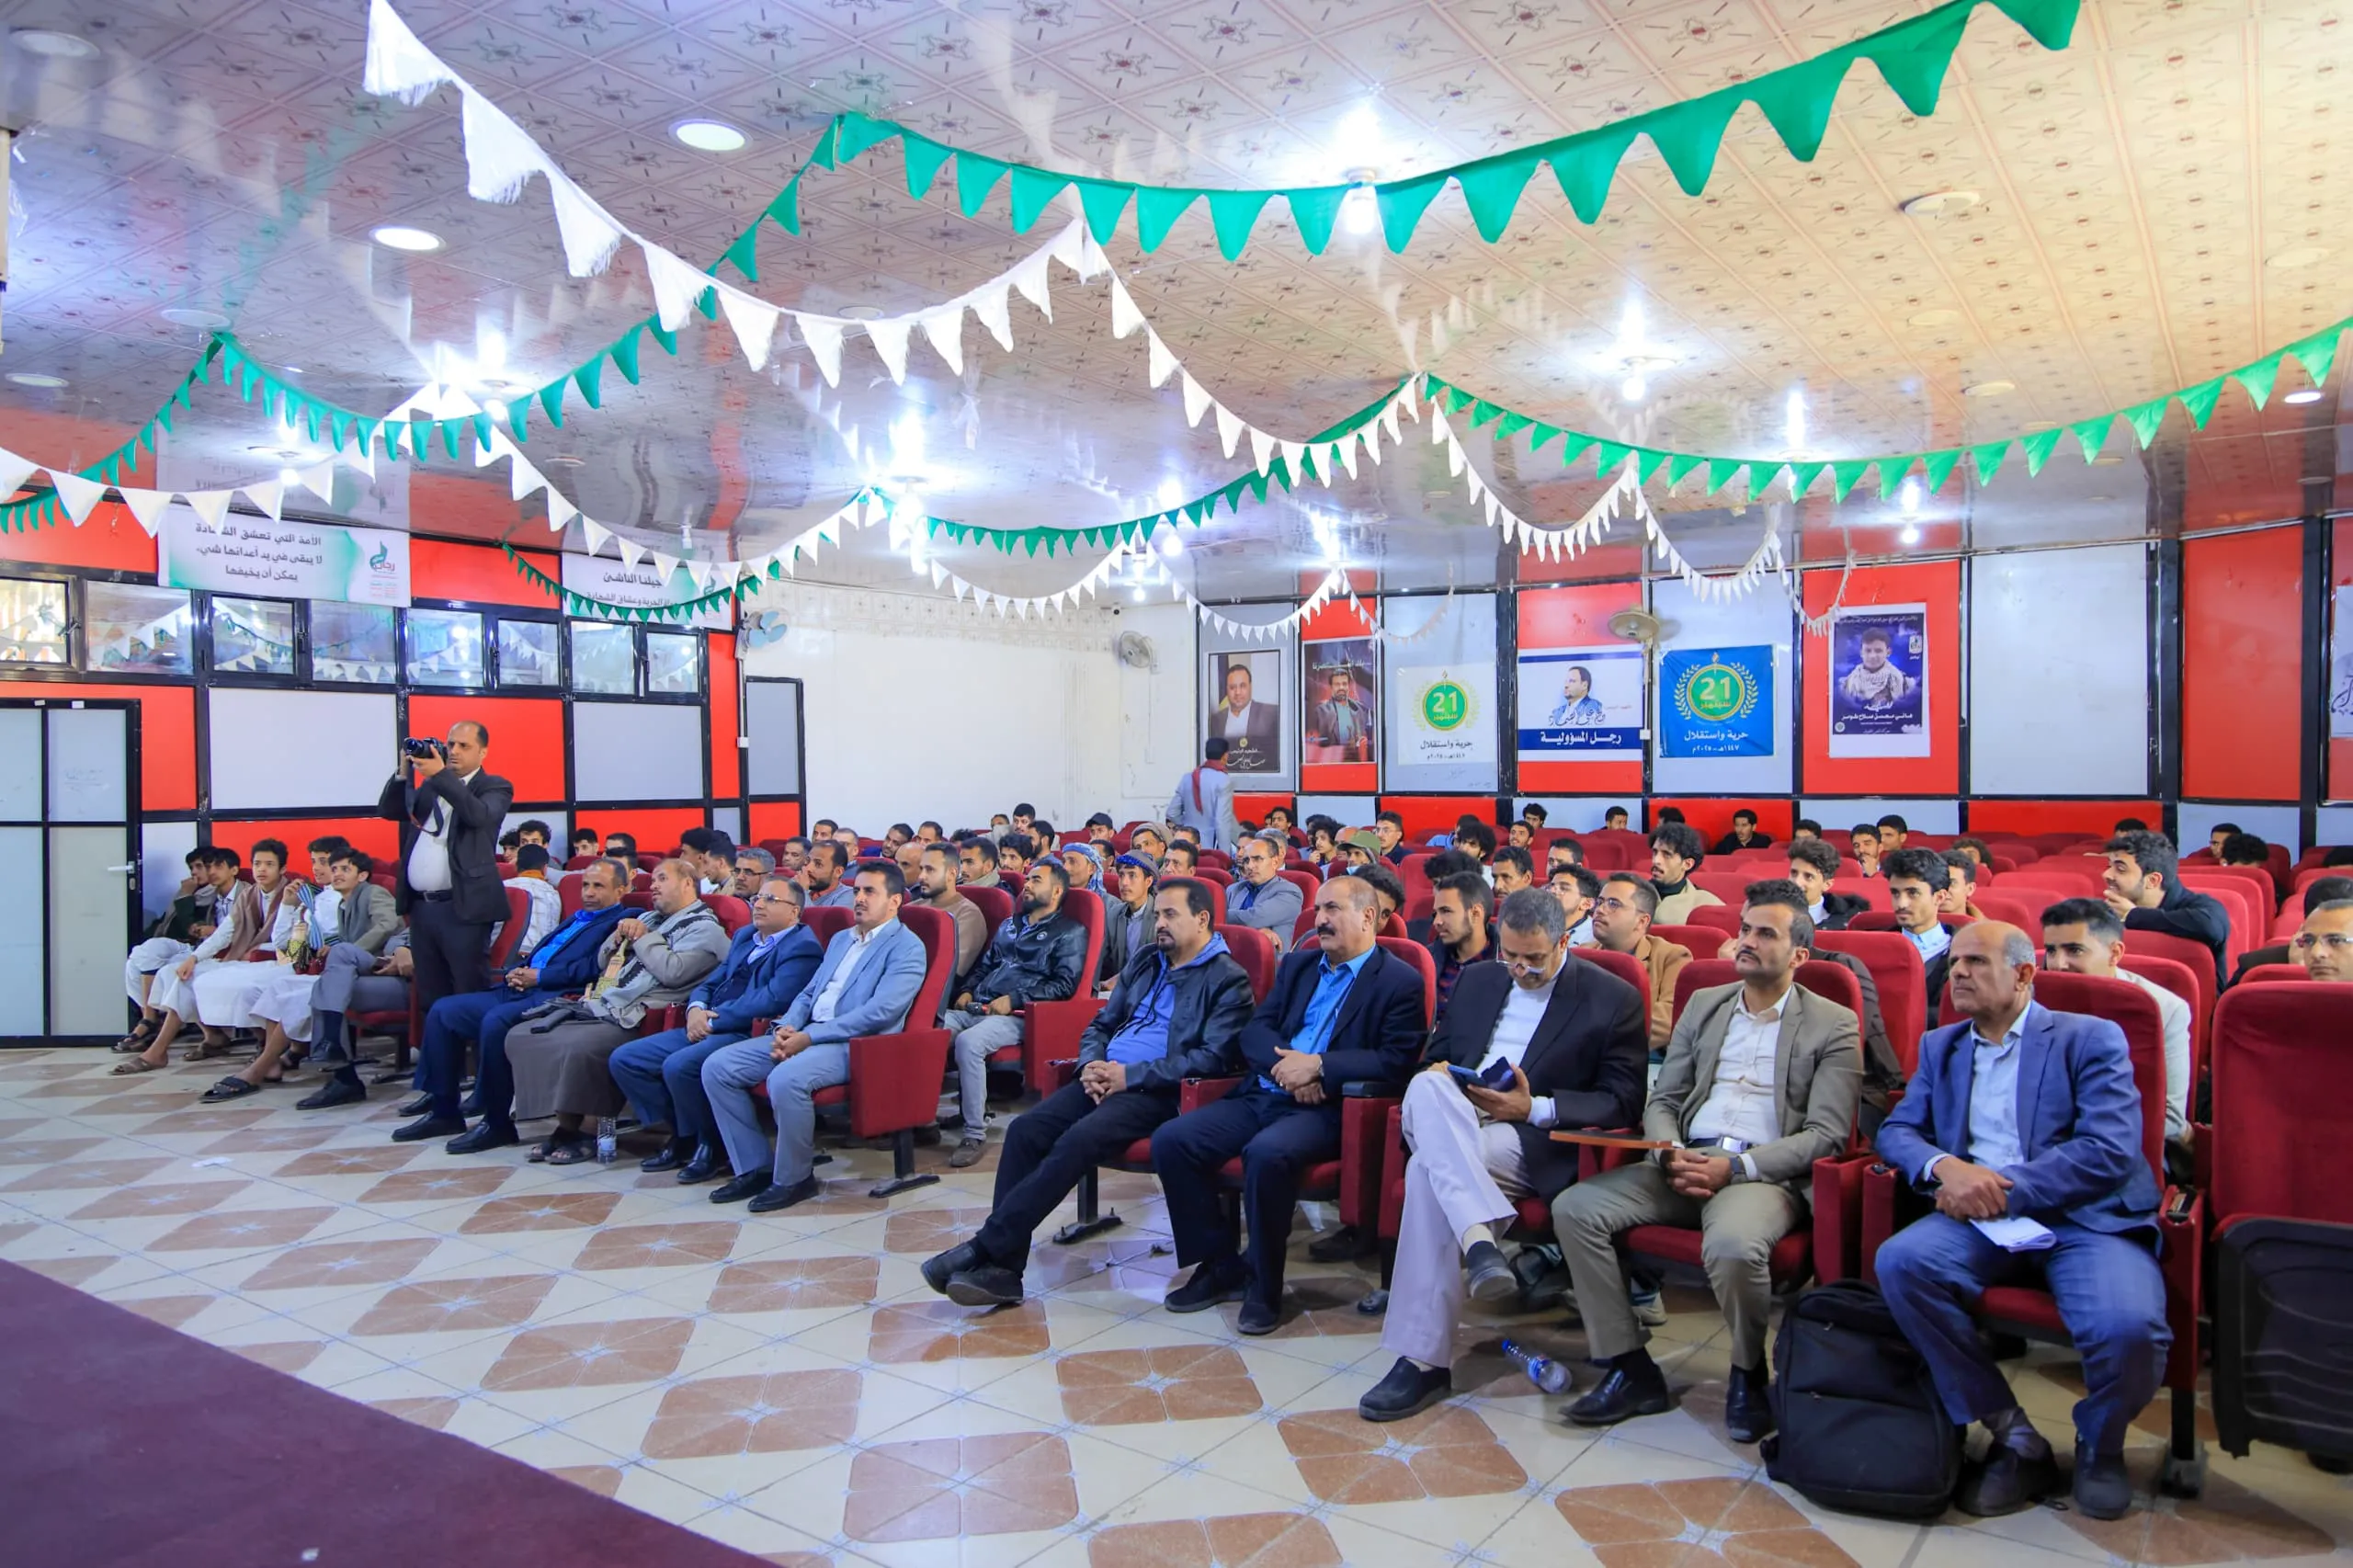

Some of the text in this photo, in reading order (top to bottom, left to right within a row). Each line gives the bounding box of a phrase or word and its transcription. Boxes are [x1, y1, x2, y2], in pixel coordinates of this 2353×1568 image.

[196, 523, 321, 546] الأمة التي تعشق الشادة
[196, 544, 221, 556] شيء
[260, 552, 270, 562] يد
[272, 553, 288, 564] في
[290, 554, 313, 565] يبقى
[315, 554, 323, 564] لا
[225, 564, 298, 583] يمكن أن يخيفها
[603, 572, 663, 588] جيلنا الناشئ
[1699, 676, 1731, 700] 21
[1433, 691, 1457, 712] 21
[1540, 731, 1621, 745] رجل المسؤولية
[1684, 730, 1748, 741] حرية واستقلال
[1420, 739, 1472, 750] حرية واستقلال
